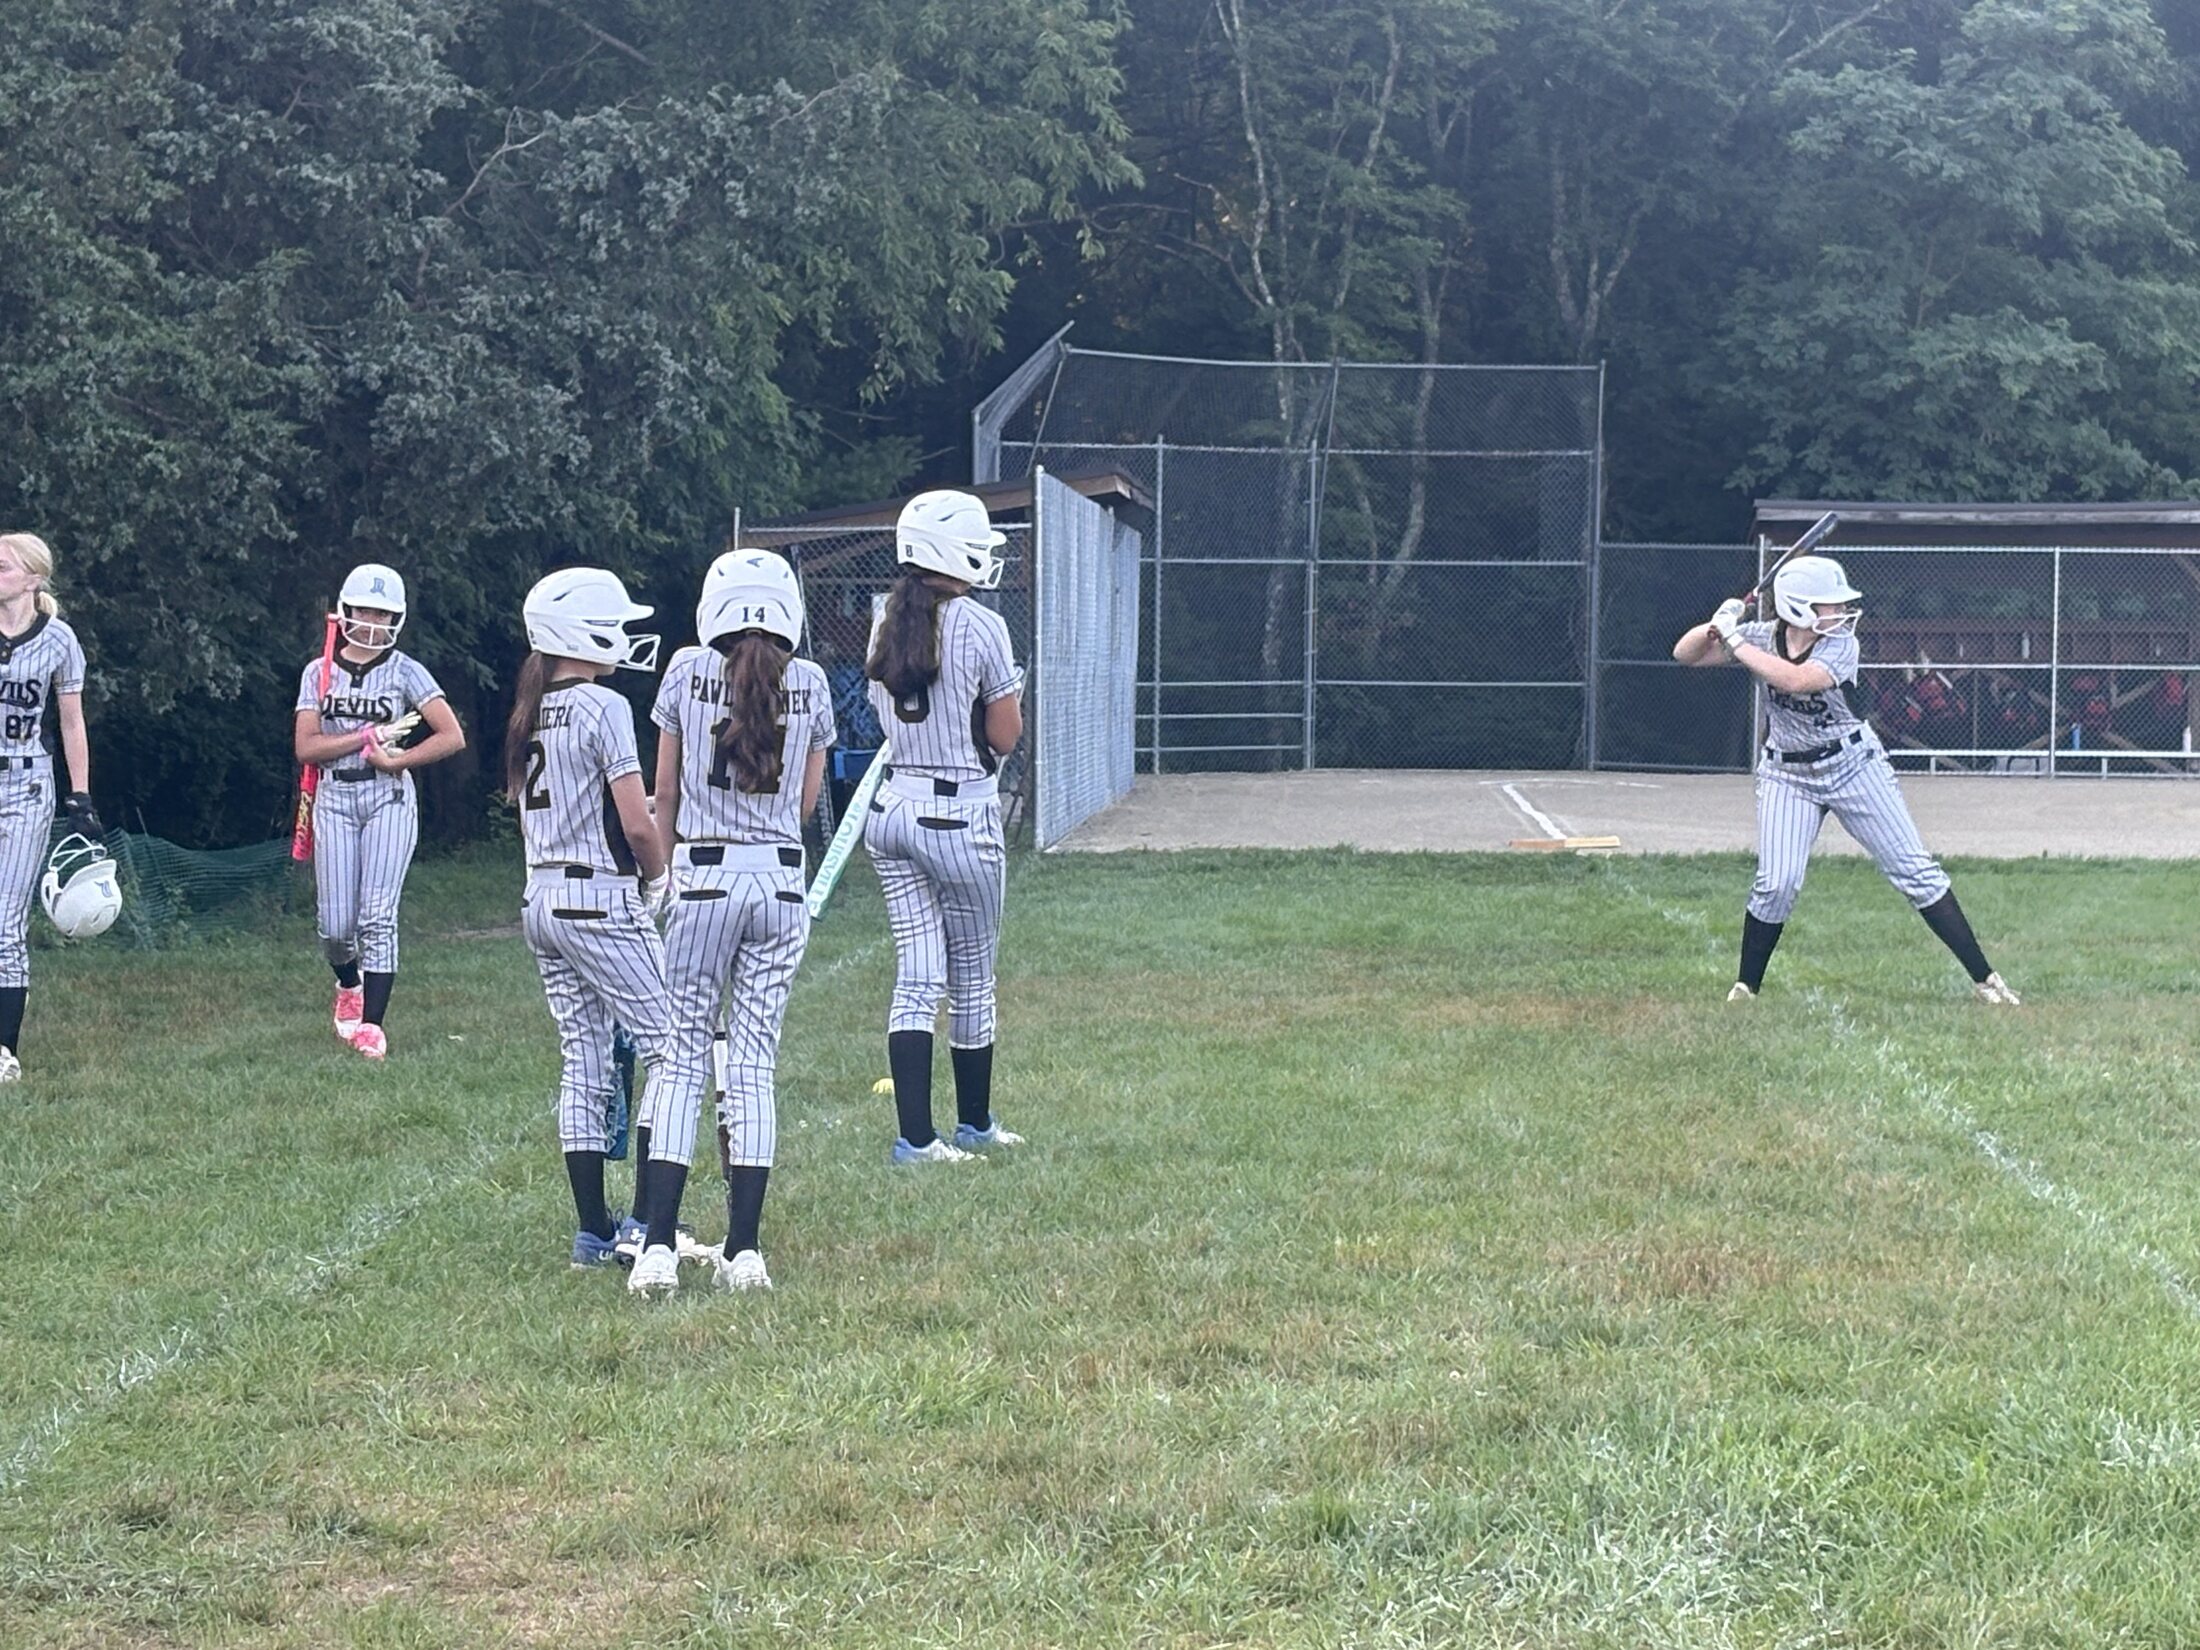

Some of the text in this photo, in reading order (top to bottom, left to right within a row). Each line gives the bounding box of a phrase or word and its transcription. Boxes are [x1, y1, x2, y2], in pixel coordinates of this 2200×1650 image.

[742, 607, 765, 622] 14
[320, 694, 393, 723] DEVILS
[6, 715, 35, 739] 87
[525, 740, 551, 811] 2
